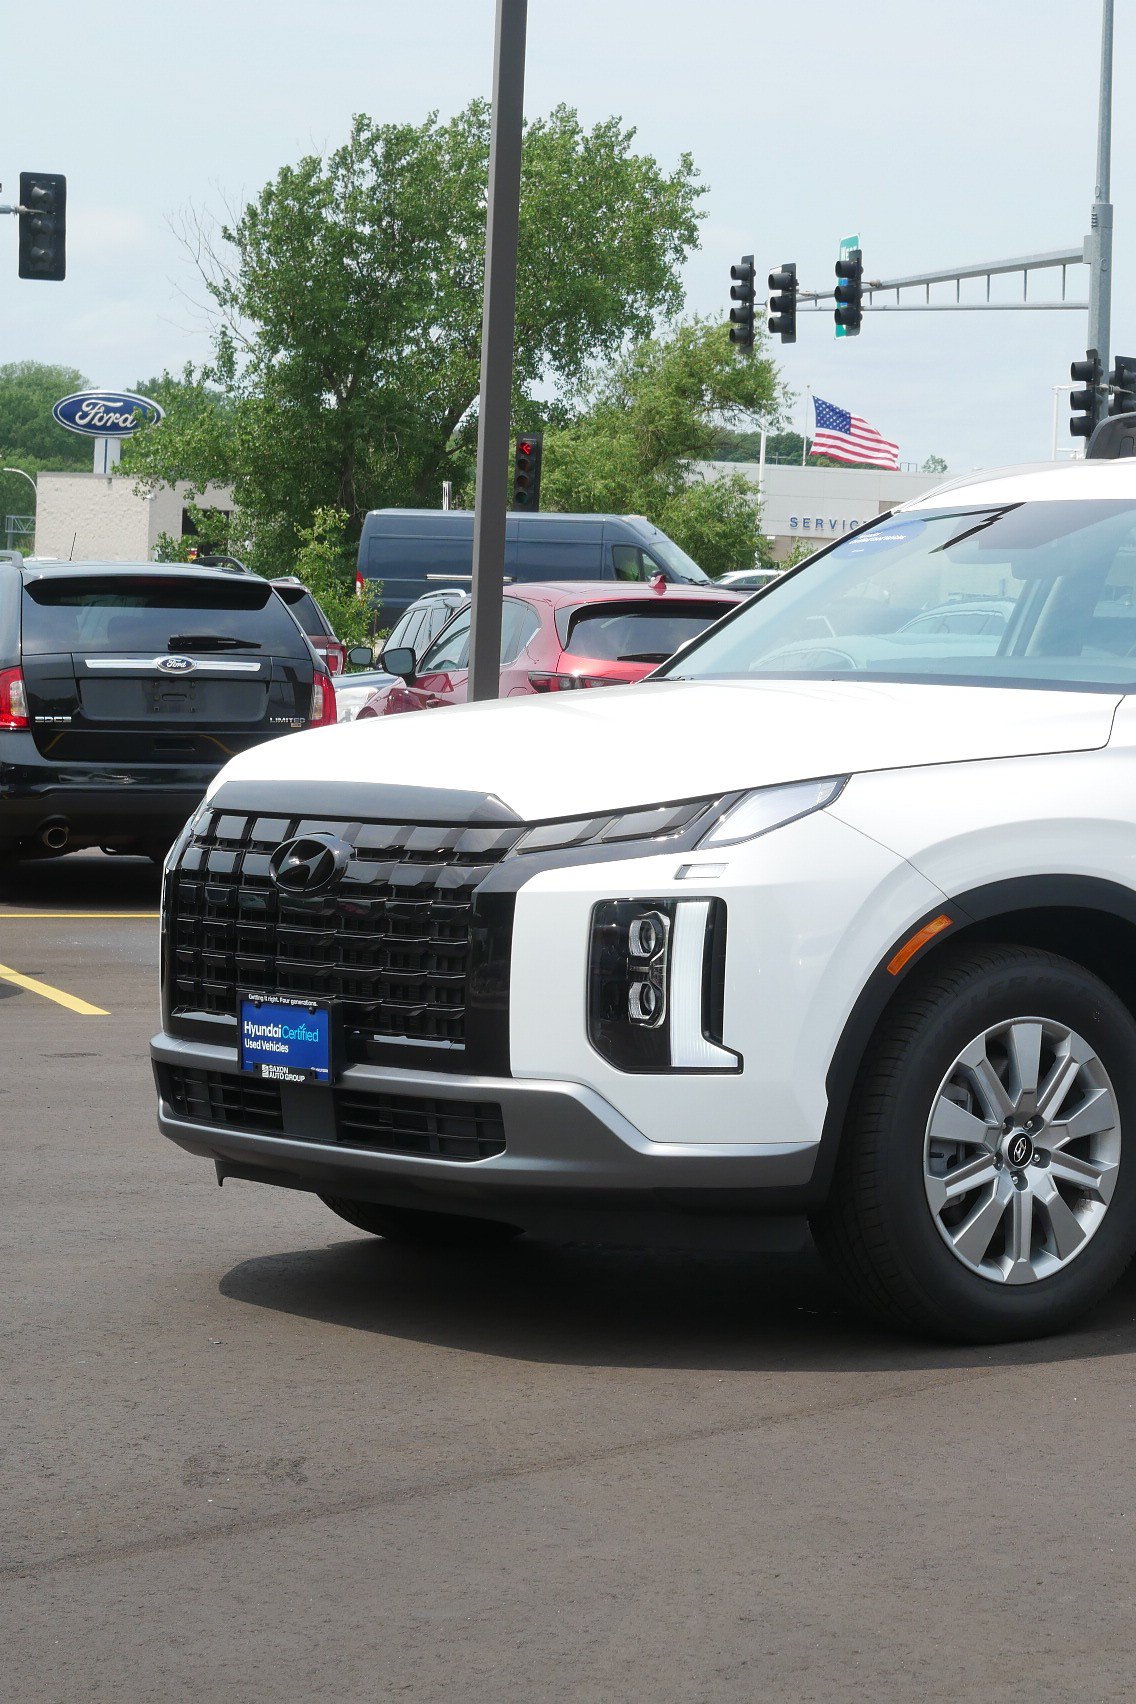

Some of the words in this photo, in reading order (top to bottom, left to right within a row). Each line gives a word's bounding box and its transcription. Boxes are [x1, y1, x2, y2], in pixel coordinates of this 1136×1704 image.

[166, 658, 187, 668] Ford
[244, 1038, 260, 1050] Used
[261, 1040, 289, 1053] Vehicles
[284, 1074, 306, 1082] GROUP
